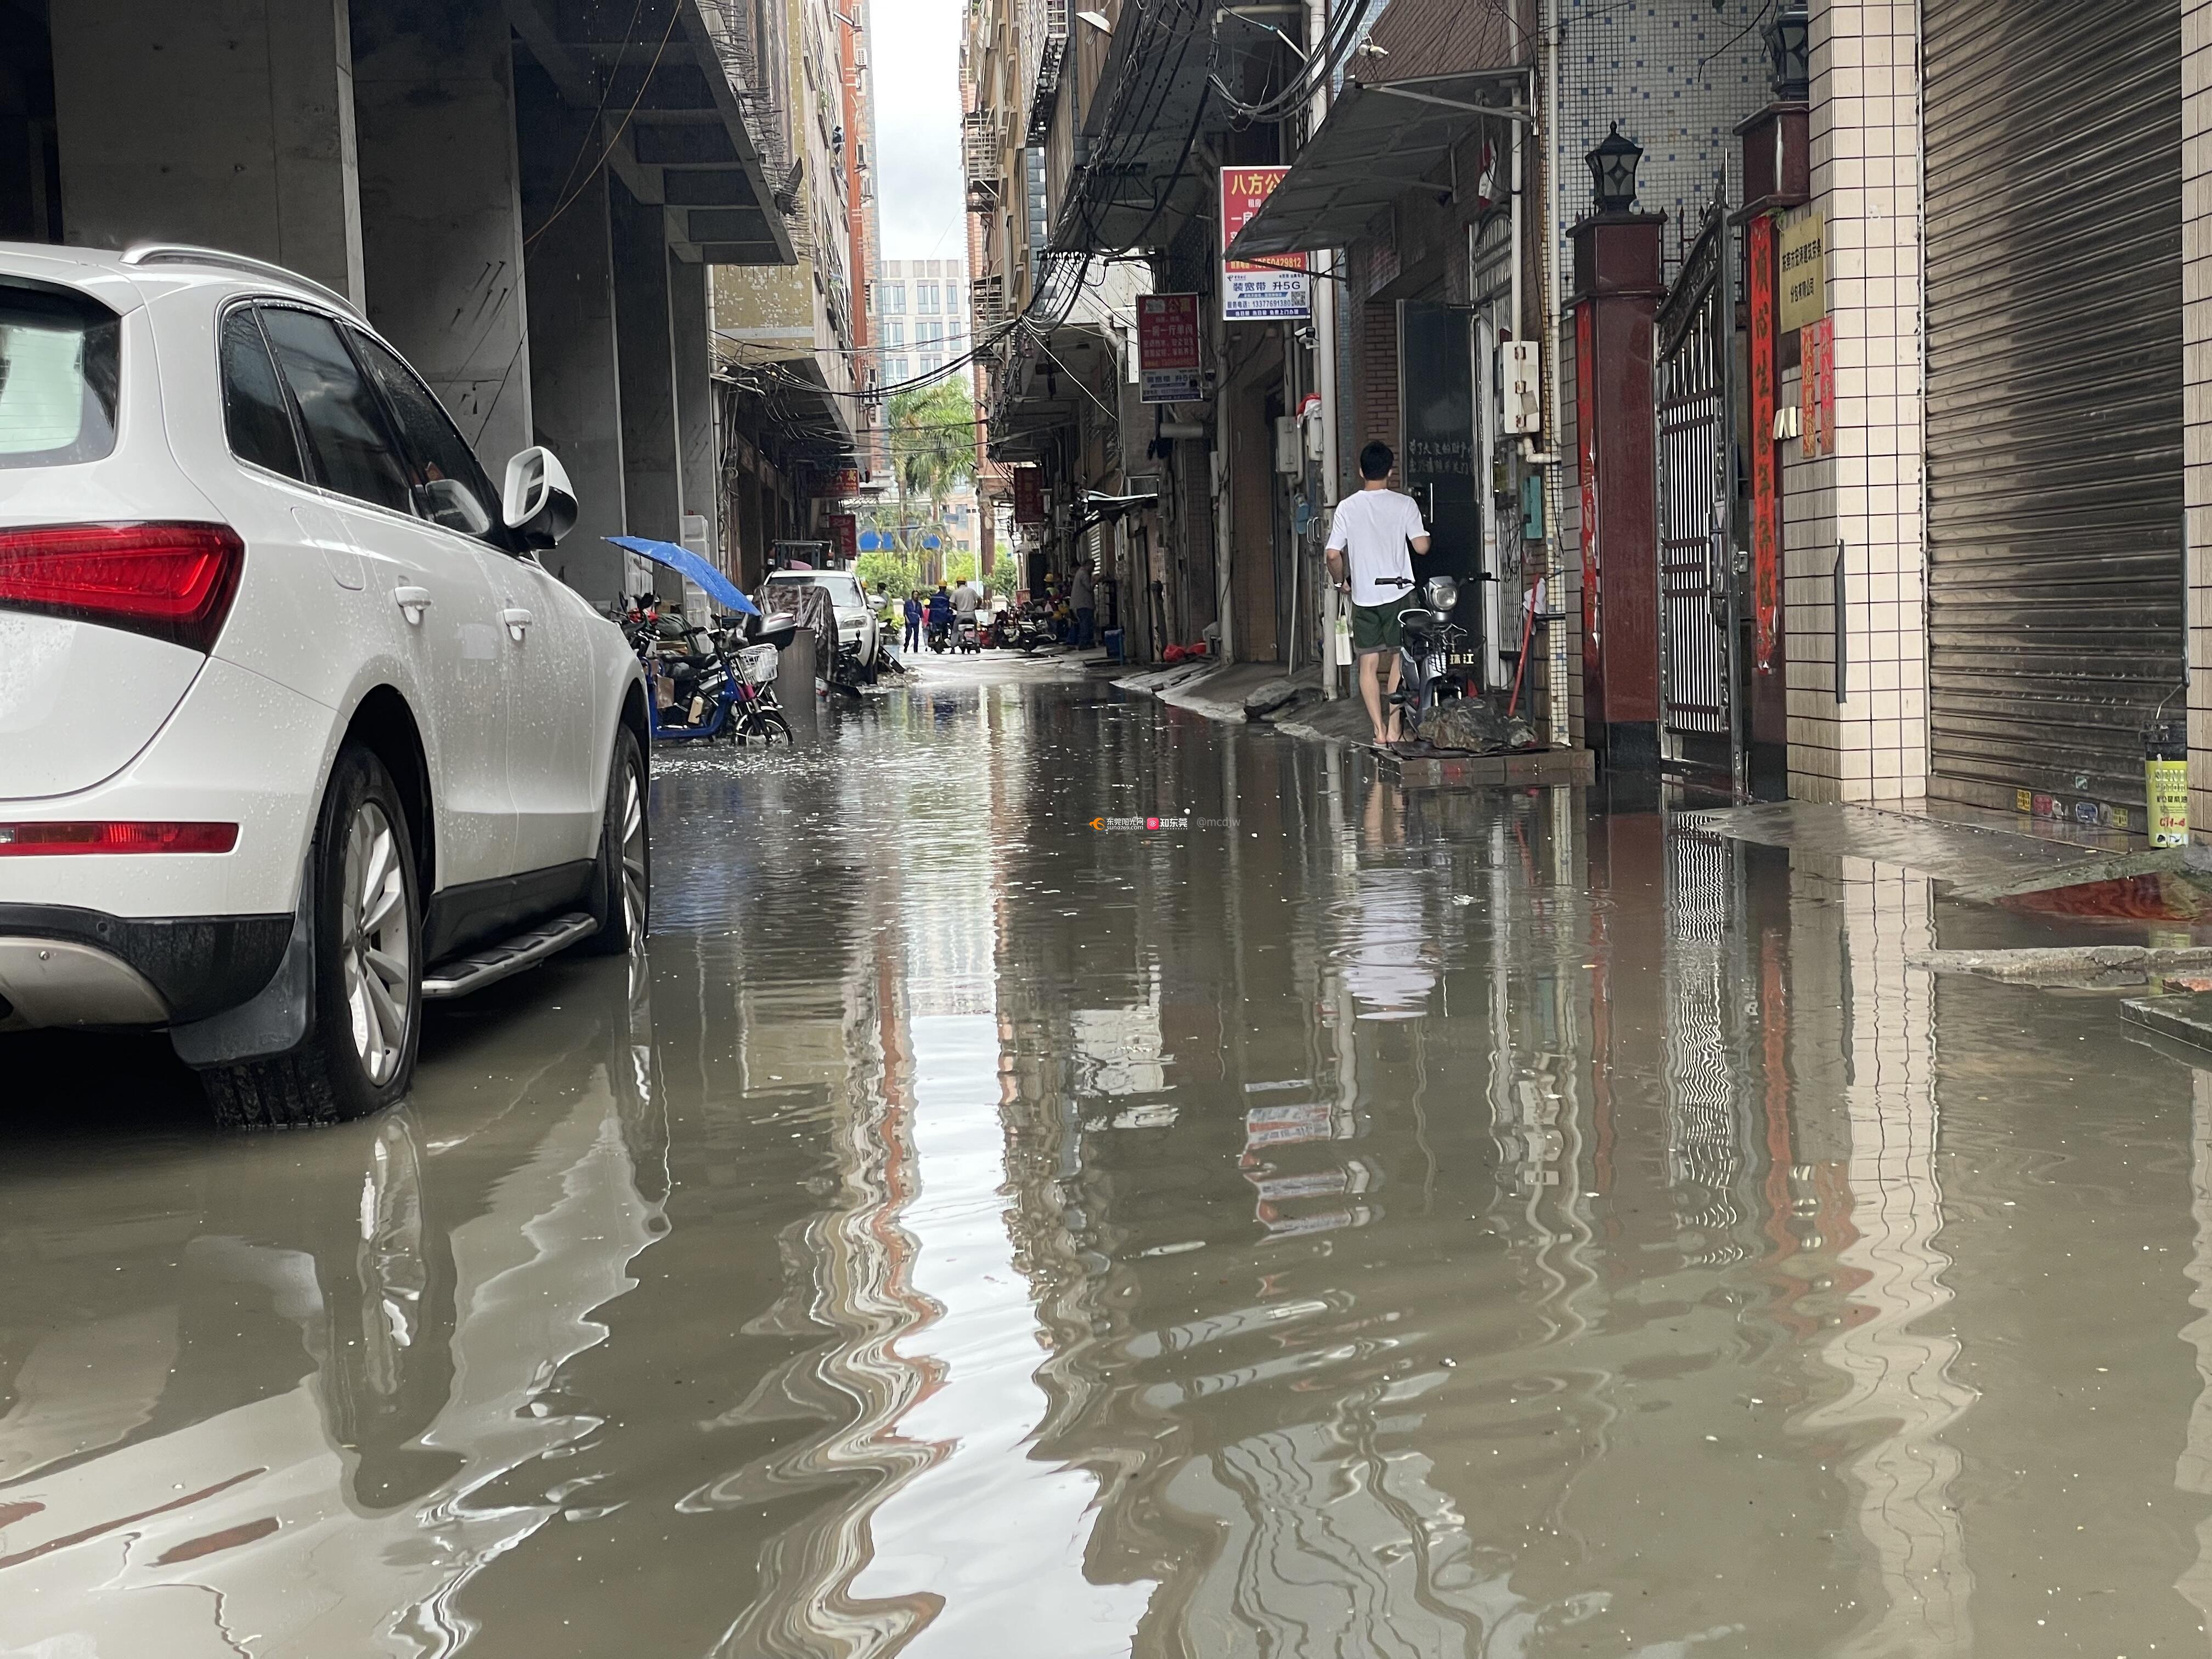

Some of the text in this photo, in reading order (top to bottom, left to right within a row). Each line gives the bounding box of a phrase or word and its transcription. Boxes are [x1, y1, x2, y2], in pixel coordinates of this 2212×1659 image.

[1231, 173, 1285, 195] 八方公
[1233, 281, 1300, 291] 装宽带 升5G
[1252, 300, 1291, 308] 13377691380
